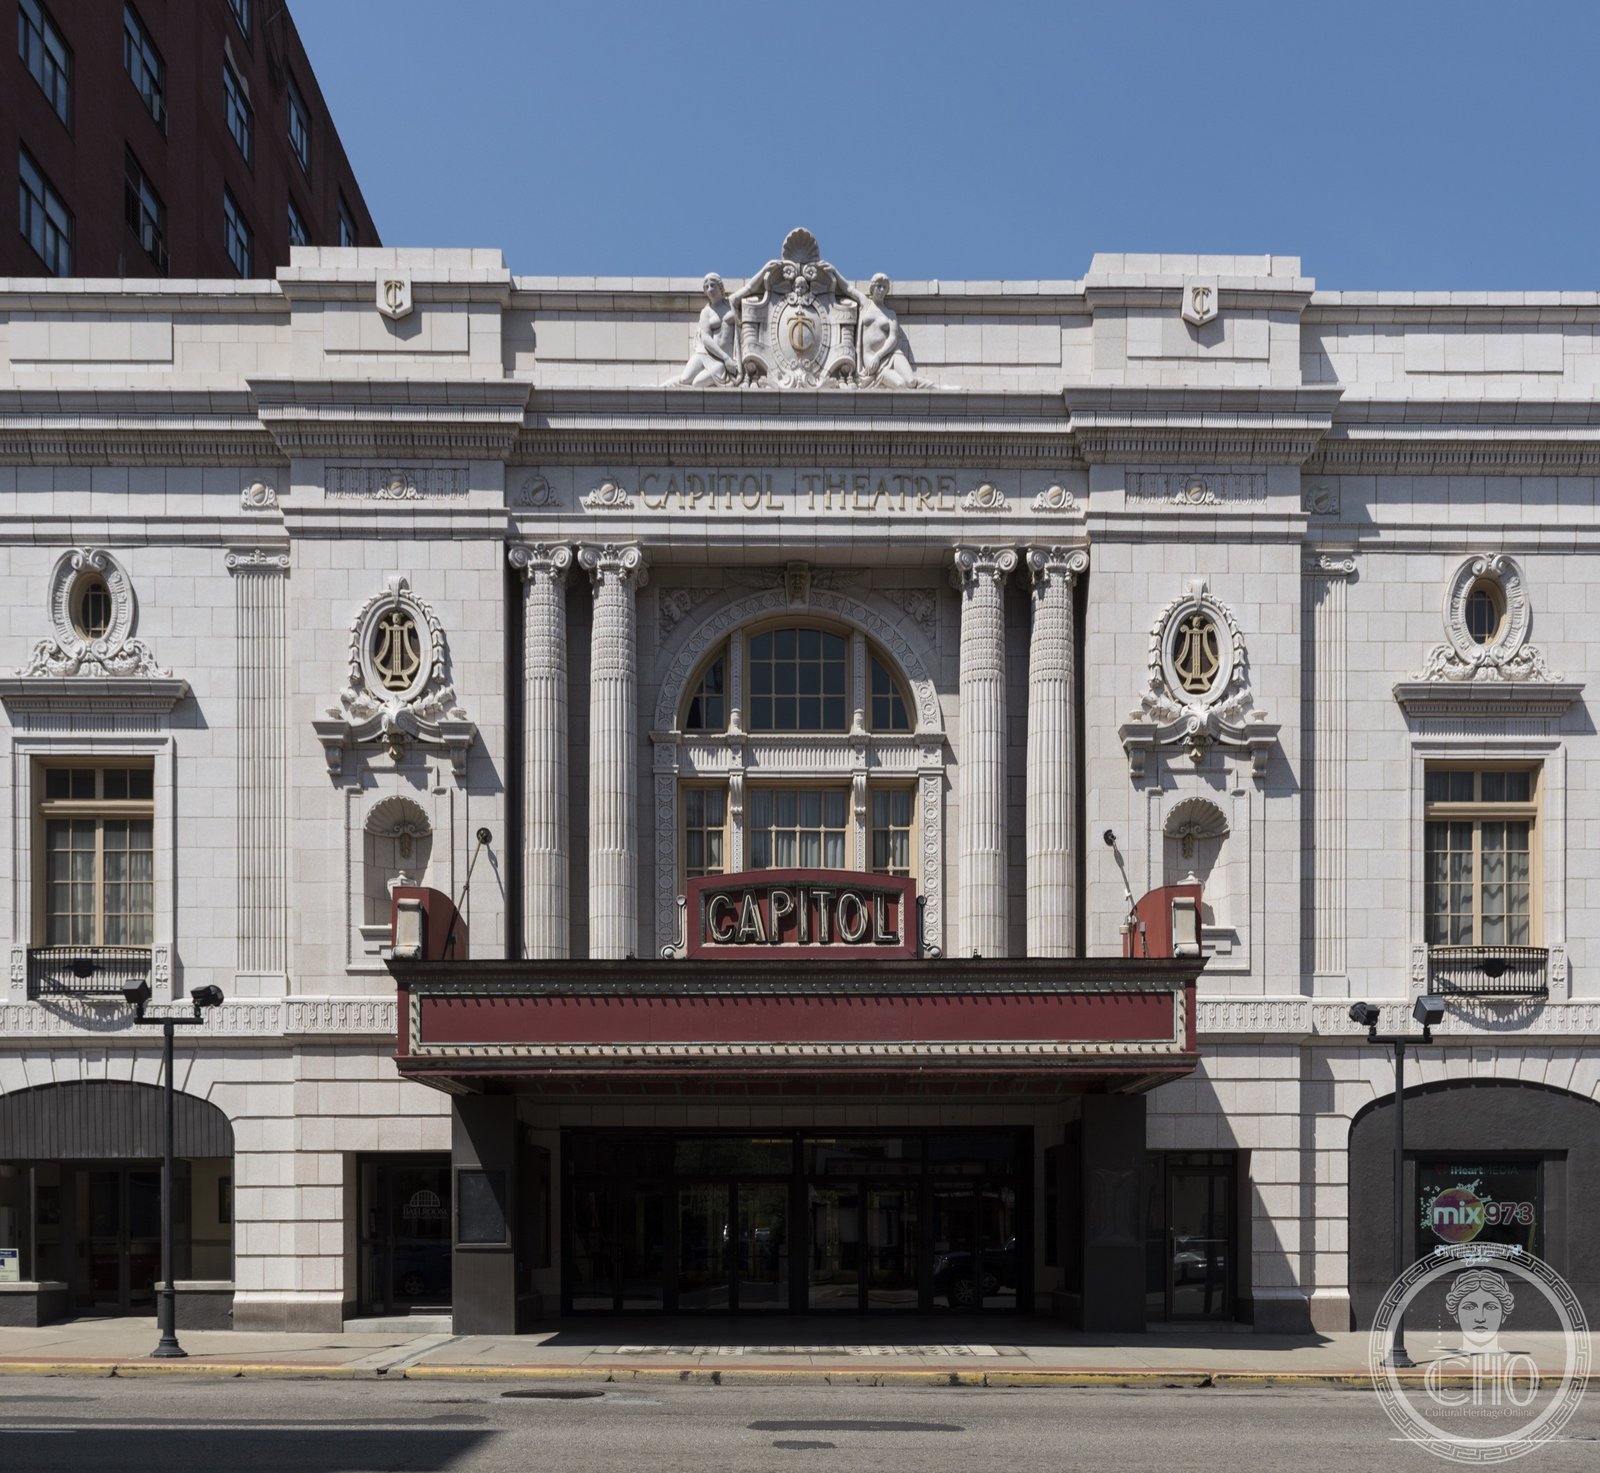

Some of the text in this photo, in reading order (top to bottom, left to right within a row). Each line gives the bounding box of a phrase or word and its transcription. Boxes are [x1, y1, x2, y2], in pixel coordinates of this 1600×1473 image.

[640, 474, 955, 511] CAPITOL THEATRE
[706, 887, 899, 943] CAPITOL
